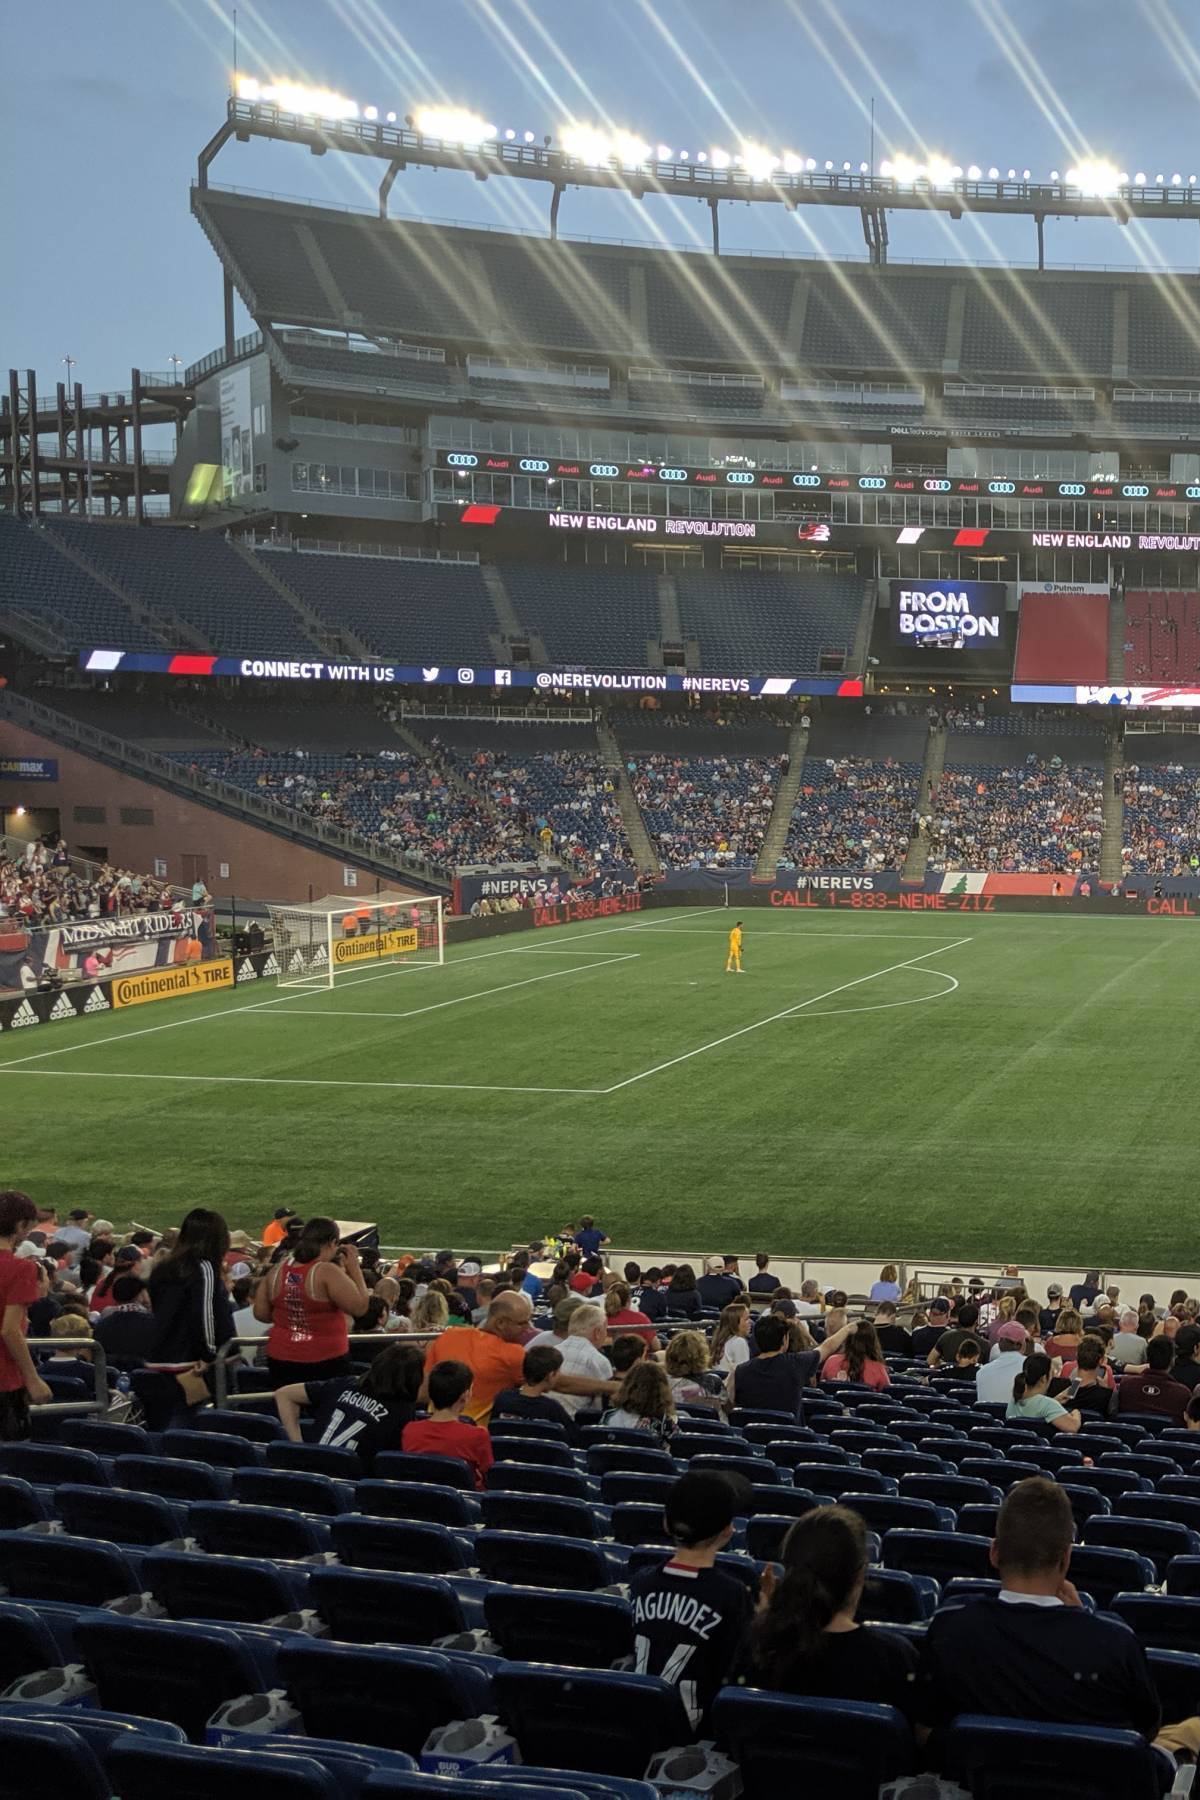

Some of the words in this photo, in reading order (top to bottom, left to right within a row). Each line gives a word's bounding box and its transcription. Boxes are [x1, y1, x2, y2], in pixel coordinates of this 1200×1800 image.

[487, 459, 509, 468] Audi
[559, 465, 578, 474] Audi
[763, 476, 784, 485] Audi
[828, 479, 849, 487] Audi
[895, 481, 913, 490] Audi
[1023, 486, 1041, 494] Audi
[1091, 487, 1113, 496] Audi
[1156, 489, 1176, 497] Audi
[550, 513, 583, 528] NEW
[587, 516, 656, 531] ENGLAND
[665, 520, 755, 536] REVOLUTION
[1033, 534, 1064, 547] NEW
[1066, 535, 1131, 548] ENGLAND
[900, 591, 969, 613] FROM
[900, 614, 999, 637] BOSTON
[241, 660, 323, 678] CONNECT
[328, 665, 369, 680] WITH
[374, 667, 394, 681] US
[536, 673, 666, 689] @NEREVOLUTION
[682, 676, 749, 692] #NEREVS
[797, 876, 873, 890] #NEREVS
[771, 890, 818, 907] CALL
[1147, 898, 1195, 915] CALL
[534, 907, 560, 927] CALL
[397, 934, 416, 946] TIRE
[237, 971, 257, 981] adidas
[118, 973, 190, 1005] Continental
[203, 967, 230, 983] TIRE
[50, 1008, 77, 1020] adidas
[83, 1001, 110, 1013] adidas
[11, 1015, 39, 1028] adidas
[337, 1390, 389, 1422] FAGUNDEZ
[631, 1592, 723, 1640] AGUNDEZ
[438, 1761, 460, 1770] BUD
